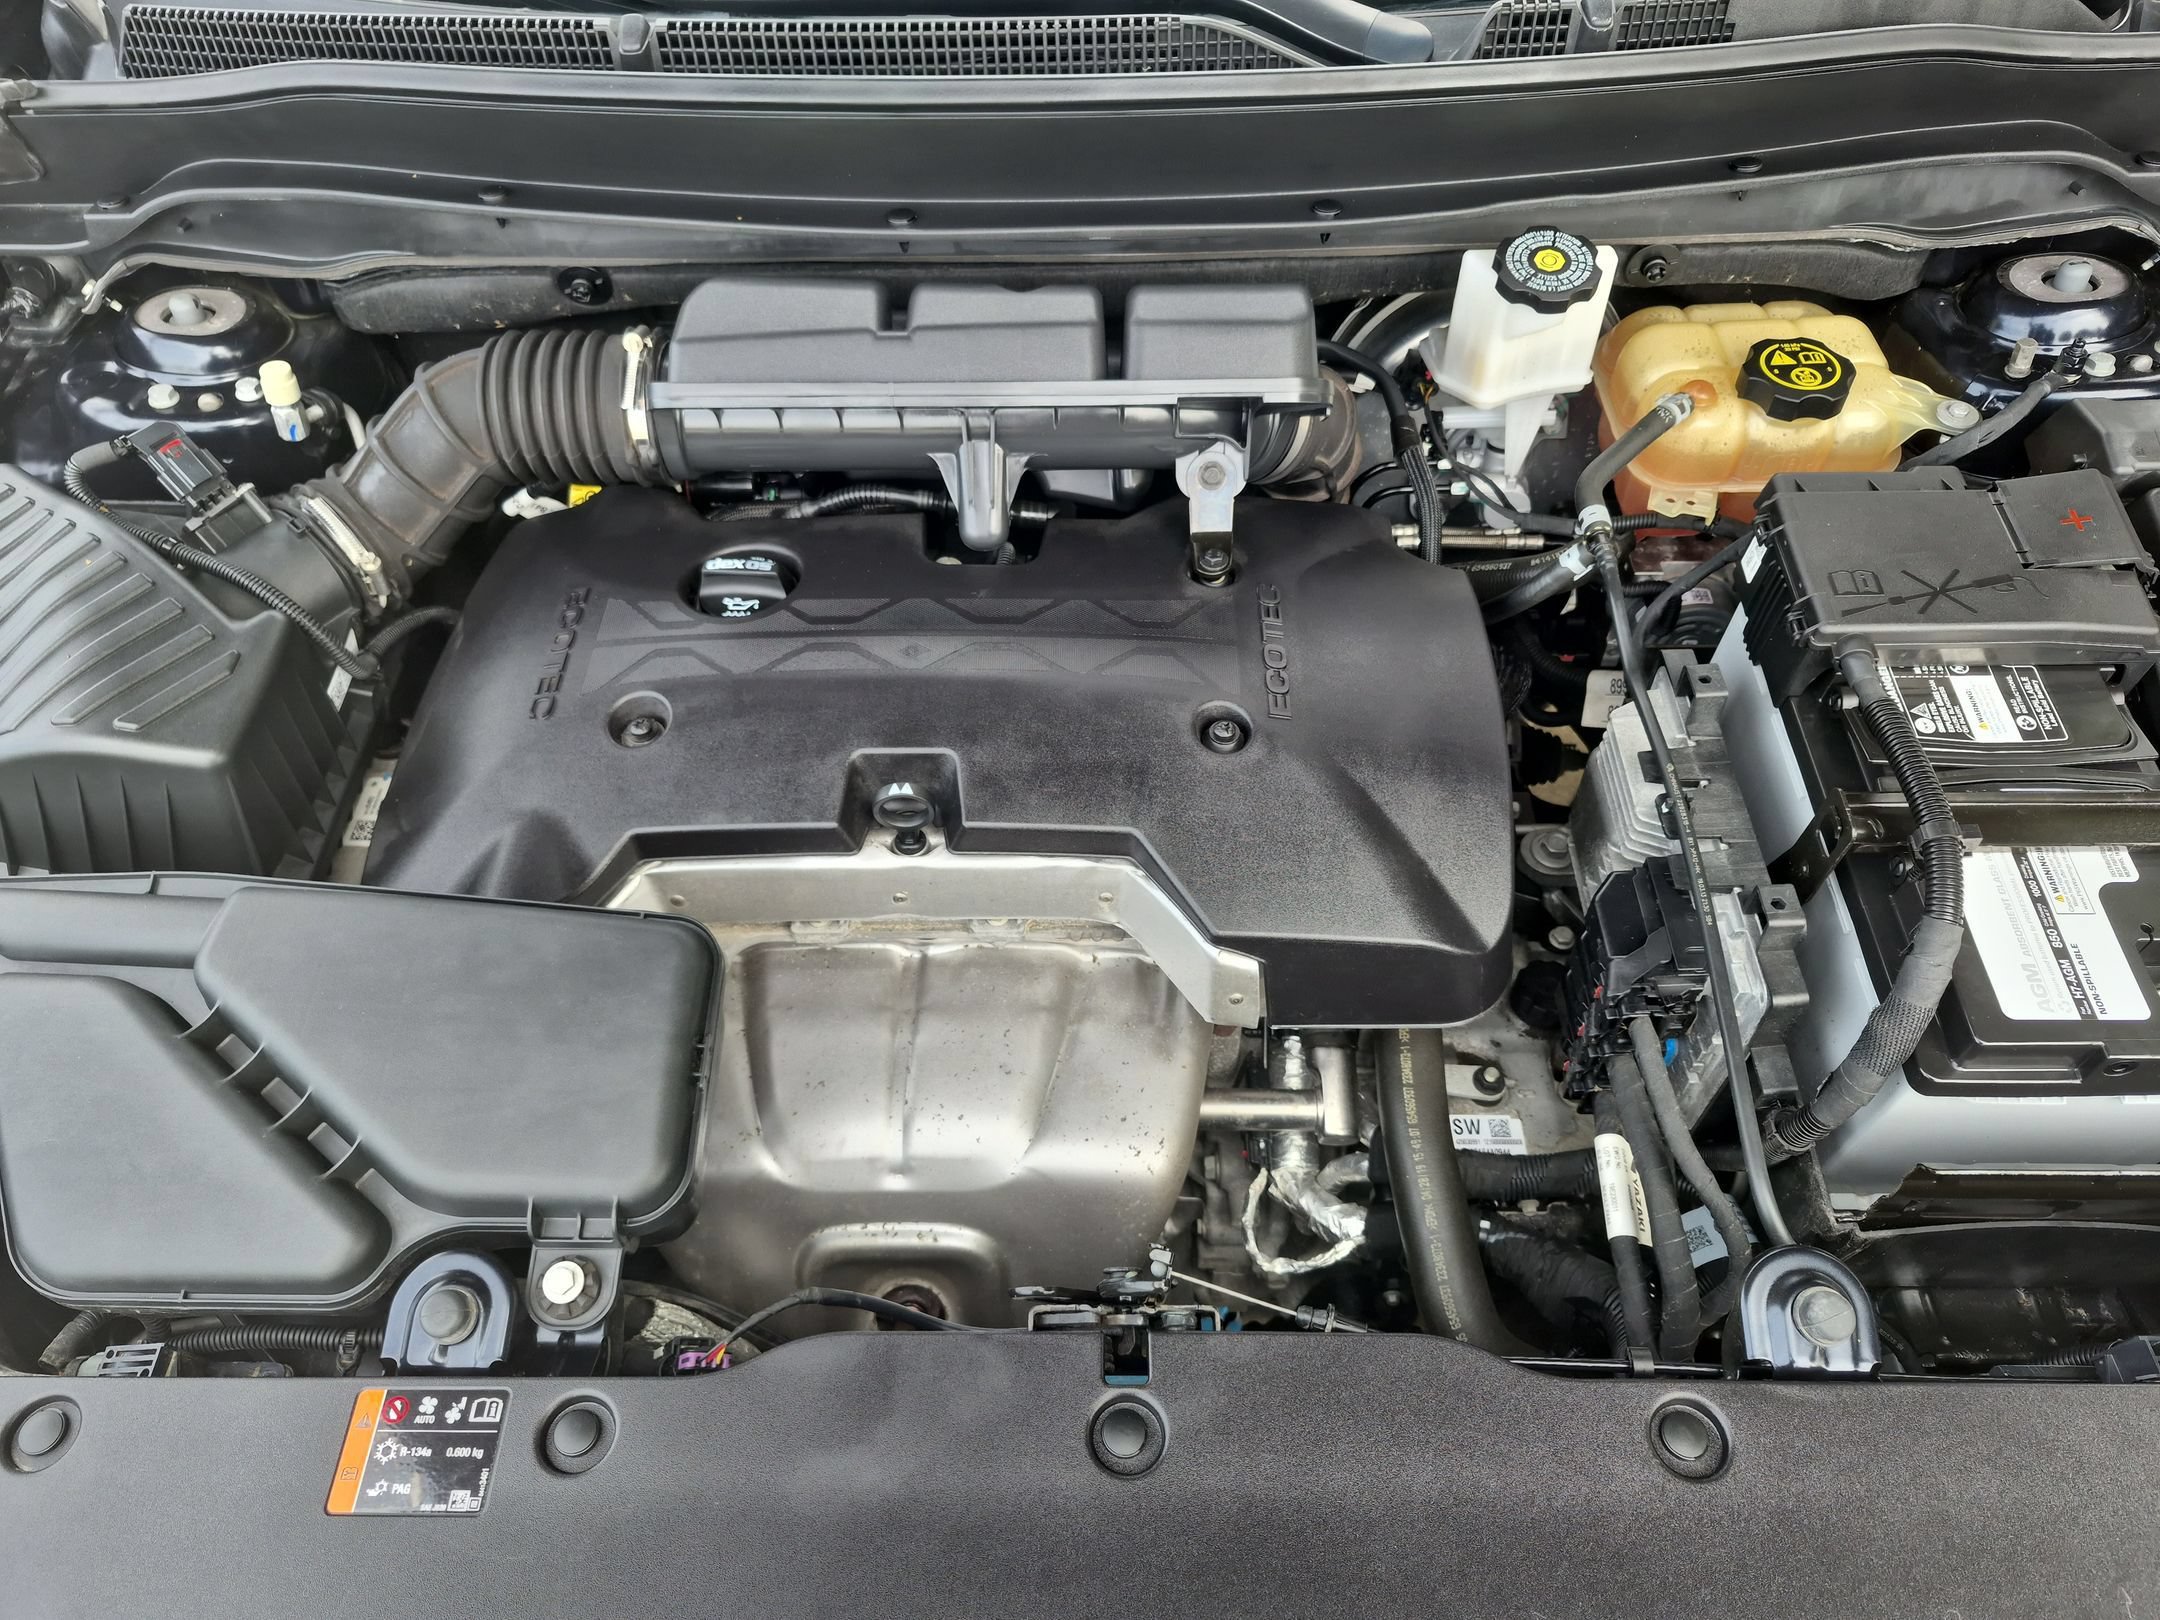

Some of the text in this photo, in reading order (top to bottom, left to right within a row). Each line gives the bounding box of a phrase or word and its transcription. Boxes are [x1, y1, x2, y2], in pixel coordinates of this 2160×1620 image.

[529, 586, 592, 720] ECOTEC
[1257, 584, 1292, 720] ECOTEC
[2019, 676, 2053, 729] NON-SPILLABLE
[2027, 880, 2043, 897] 1000
[2046, 928, 2064, 947] 850
[2058, 959, 2085, 998] H7-AGM
[2069, 942, 2108, 1014] NON-SPILLABLE
[1453, 1118, 1480, 1136] SW
[1633, 1180, 1646, 1232] YAZAKI
[414, 1416, 436, 1424] AUTO
[400, 1447, 484, 1460] R-134a 0.600 kg
[392, 1484, 411, 1494] PAG
